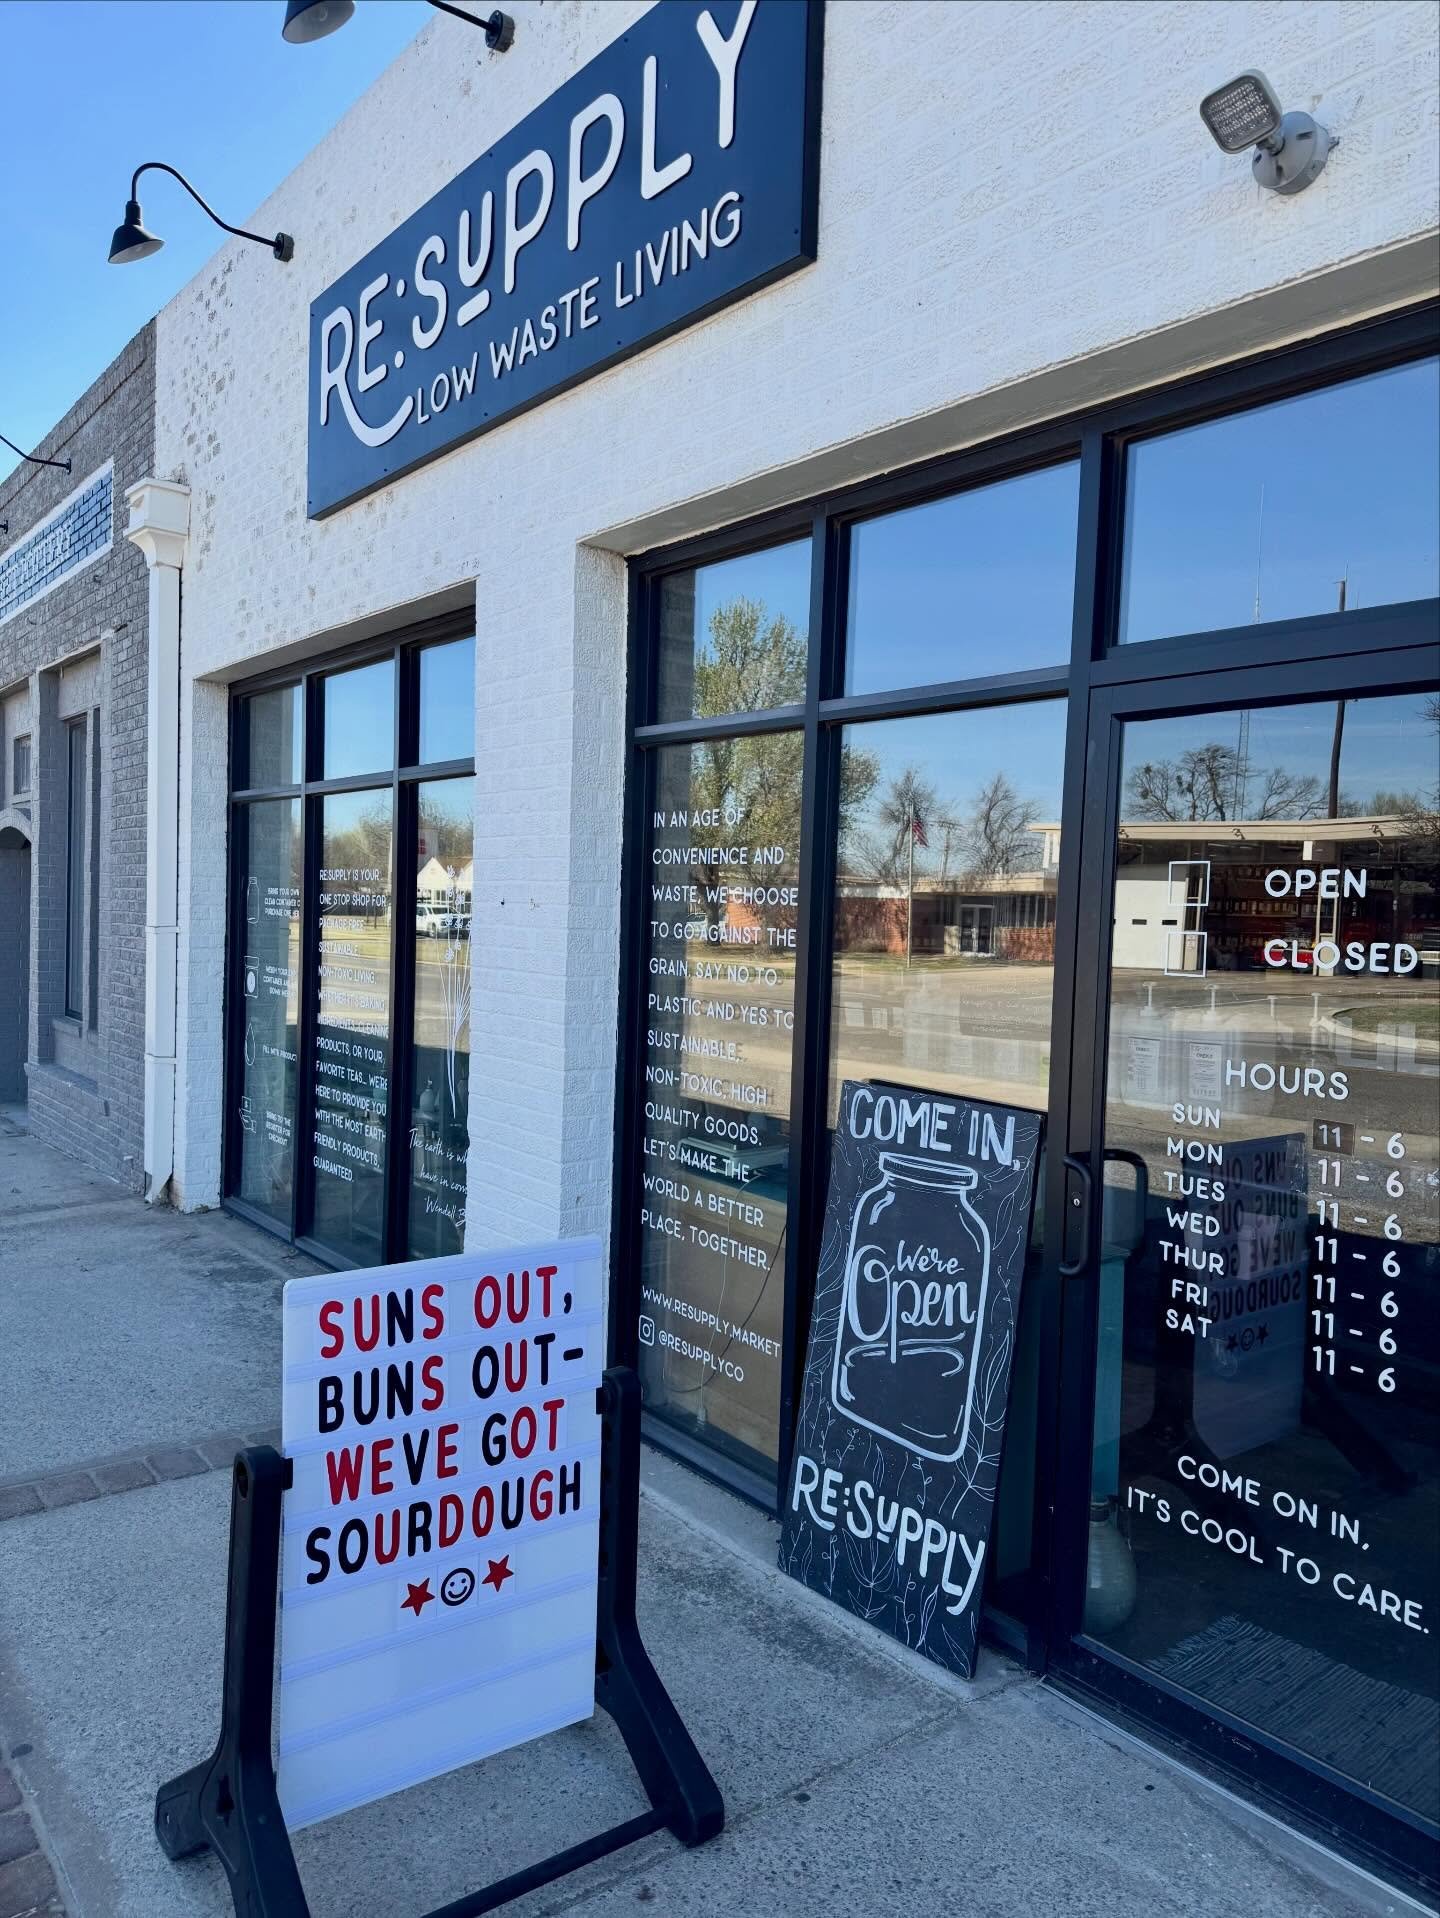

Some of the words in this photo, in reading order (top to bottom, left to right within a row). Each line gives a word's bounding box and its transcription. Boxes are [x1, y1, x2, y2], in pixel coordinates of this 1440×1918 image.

[320, 0, 757, 447] RE:SUPPLY
[416, 352, 478, 424] LOW
[490, 276, 600, 379] WASTE
[615, 191, 741, 308] LIVING
[653, 811, 665, 828] IN
[670, 810, 687, 828] AN
[692, 808, 720, 827] AGE
[725, 807, 745, 825] OF
[353, 869, 358, 881] IS
[361, 869, 380, 881] YOUR
[652, 847, 748, 865] CONVENIENCE
[753, 846, 784, 864] AND
[319, 893, 332, 905] ONE
[334, 893, 351, 906] STOP
[351, 894, 371, 907] SHOP
[372, 894, 387, 908] FOR
[651, 884, 701, 905] WASTE,
[706, 885, 728, 904] WE
[734, 886, 799, 906] CHOOSE
[1264, 868, 1367, 899] OPEN
[651, 921, 669, 938] TO
[673, 922, 695, 939] GO
[699, 924, 761, 945] AGAINST
[767, 927, 797, 948] THE
[1264, 938, 1419, 974] CLOSED
[695, 962, 722, 982] SAY
[727, 963, 749, 983] NO
[756, 967, 778, 986] TO
[648, 993, 702, 1016] PLASTIC
[706, 1000, 735, 1021] AND
[740, 1005, 768, 1025] YES
[774, 1009, 794, 1030] TO
[316, 1036, 352, 1056] PRODUCTS,
[352, 1044, 363, 1058] OR
[363, 1047, 383, 1064] YOUR
[647, 1029, 740, 1063] SUSTAINABLE,
[315, 1060, 345, 1079] FAVORITE
[646, 1065, 728, 1100] NON-TOXIC,
[730, 1083, 768, 1107] HIGH
[1224, 1058, 1349, 1101] HOURS
[315, 1083, 331, 1100] HERE
[331, 1088, 341, 1102] TO
[342, 1092, 370, 1112] PROVIDE
[371, 1100, 387, 1117] YOU
[850, 1088, 956, 1153] COME
[314, 1131, 342, 1151] FRIENDLY
[315, 1107, 331, 1124] WITH
[331, 1113, 344, 1128] THE
[344, 1118, 364, 1135] MOST
[364, 1124, 386, 1143] EARTH
[409, 1128, 424, 1149] The
[424, 1138, 444, 1156] earth
[446, 1148, 455, 1160] is
[645, 1101, 700, 1130] QUALITY
[704, 1115, 762, 1147] GOODS.
[1172, 1102, 1220, 1129] SUN
[1318, 1124, 1341, 1148] 11
[1386, 1132, 1406, 1159] 6
[313, 1155, 355, 1183] GUARANTEED.
[420, 1163, 438, 1182] have
[440, 1175, 449, 1188] in
[643, 1136, 676, 1160] LET'S
[680, 1147, 717, 1174] MAKE
[723, 1158, 750, 1183] THE
[1167, 1136, 1223, 1166] MON
[1318, 1159, 1341, 1187] 11
[1386, 1171, 1404, 1198] 6
[643, 1172, 690, 1203] WORLD
[694, 1190, 704, 1208] A
[708, 1194, 764, 1228] BETTER
[1164, 1170, 1225, 1202] TUES
[1316, 1200, 1339, 1229] 11
[1383, 1213, 1402, 1240] 6
[641, 1208, 685, 1241] PLACE,
[689, 1225, 771, 1271] TOGETHER.
[897, 1239, 965, 1275] We're
[1166, 1206, 1220, 1237] WED
[1314, 1236, 1338, 1264] 11
[1382, 1250, 1401, 1278] 6
[1159, 1240, 1224, 1276] THUR
[1313, 1274, 1336, 1303] 11
[1380, 1291, 1399, 1318] 6
[318, 1283, 445, 1359] SUNS
[474, 1265, 573, 1330] OUT,
[642, 1284, 781, 1359] WWW.RESUPPLY.MARKET
[850, 1244, 978, 1363] Open
[1171, 1279, 1208, 1307] FRI
[1311, 1310, 1334, 1339] 11
[1378, 1327, 1397, 1355] 6
[658, 1330, 745, 1382] @RESUPPLYCO
[1165, 1309, 1212, 1338] SAT
[1312, 1346, 1335, 1376] 11
[1377, 1367, 1396, 1393] 6
[318, 1354, 445, 1434] BUNS
[326, 1423, 460, 1506] WEVE
[481, 1398, 565, 1467] GOT
[1177, 1455, 1261, 1507] COME
[1272, 1491, 1318, 1529] ON
[305, 1460, 582, 1585] SOURDOUGH
[1127, 1486, 1171, 1523] IT'S
[1180, 1509, 1264, 1565] COOL
[1276, 1546, 1321, 1585] TO
[1333, 1572, 1430, 1635] CARE.
